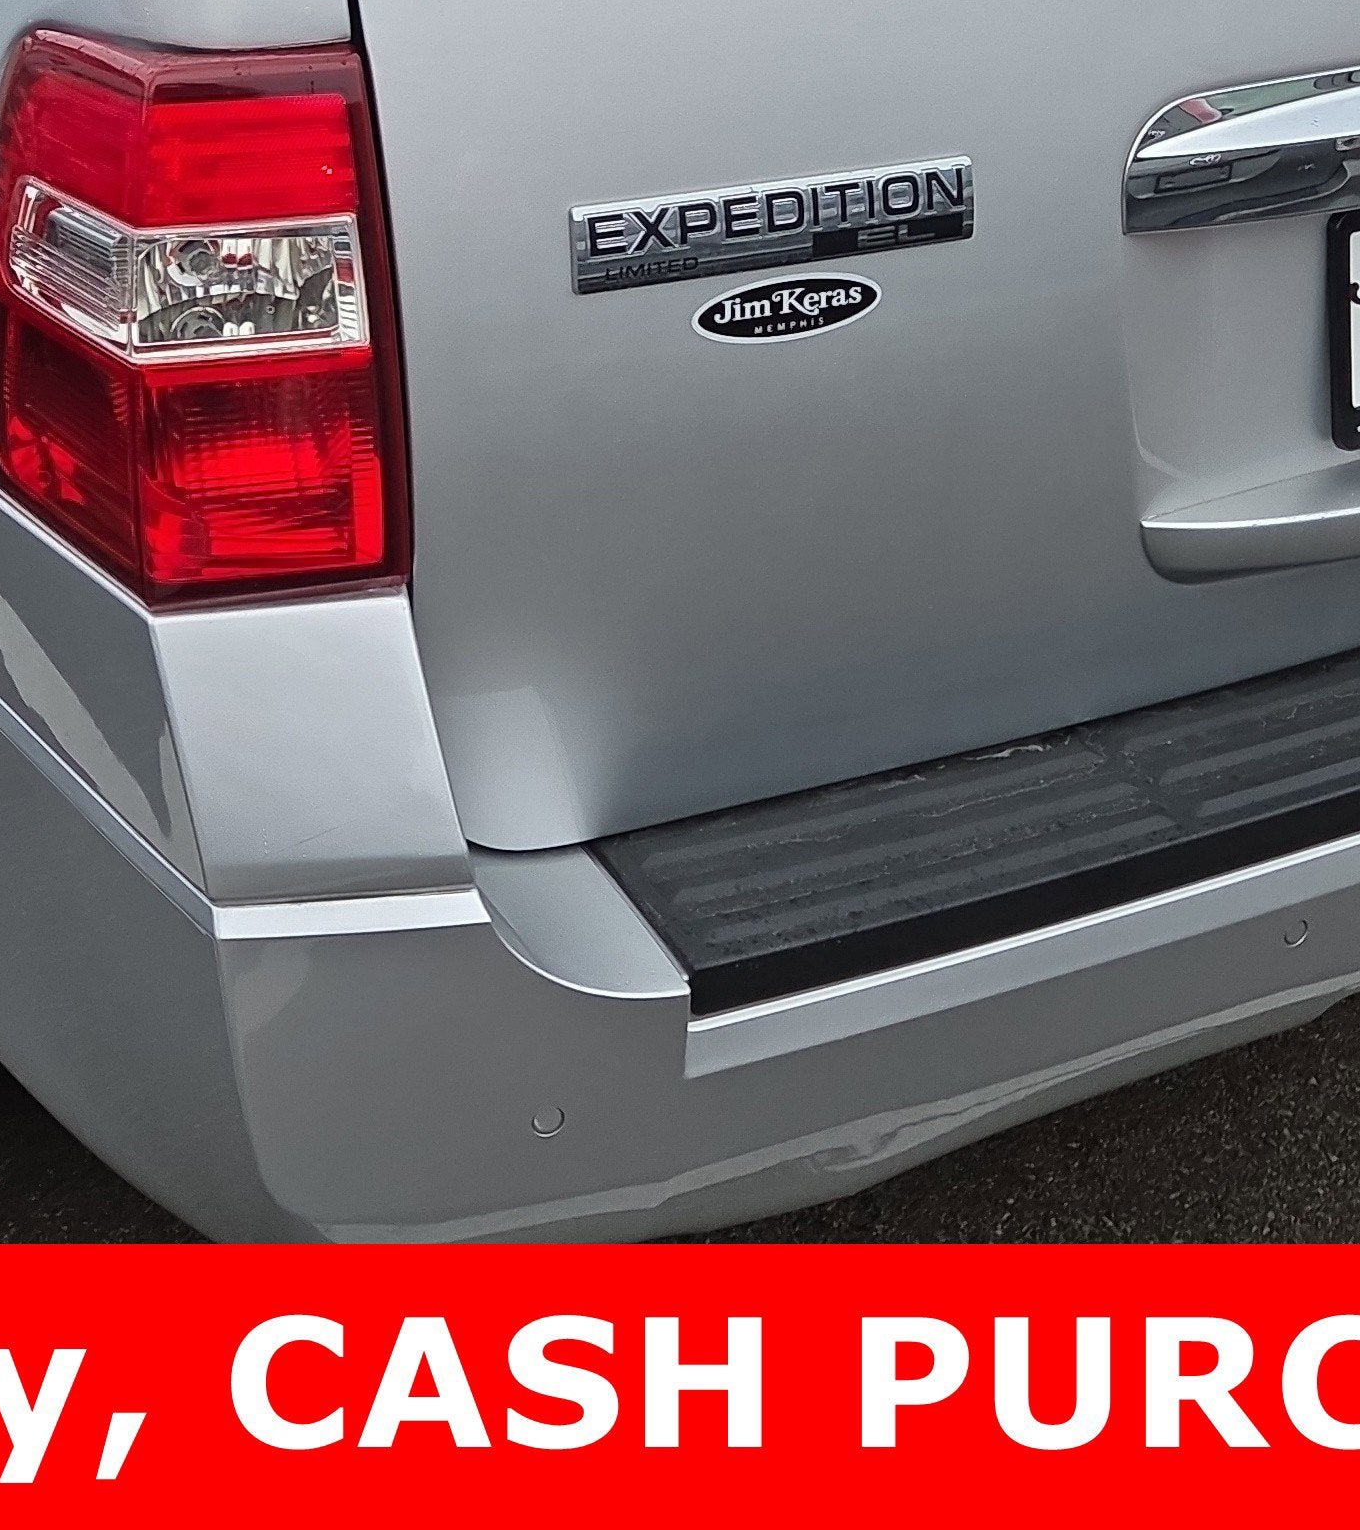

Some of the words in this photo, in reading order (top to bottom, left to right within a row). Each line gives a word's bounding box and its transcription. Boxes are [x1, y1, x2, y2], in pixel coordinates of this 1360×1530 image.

[583, 164, 968, 259] EXPEDITION
[605, 256, 700, 281] LIMITED
[713, 297, 772, 324] Jim
[771, 286, 862, 316] Keras
[753, 317, 824, 334] MEMPHIS
